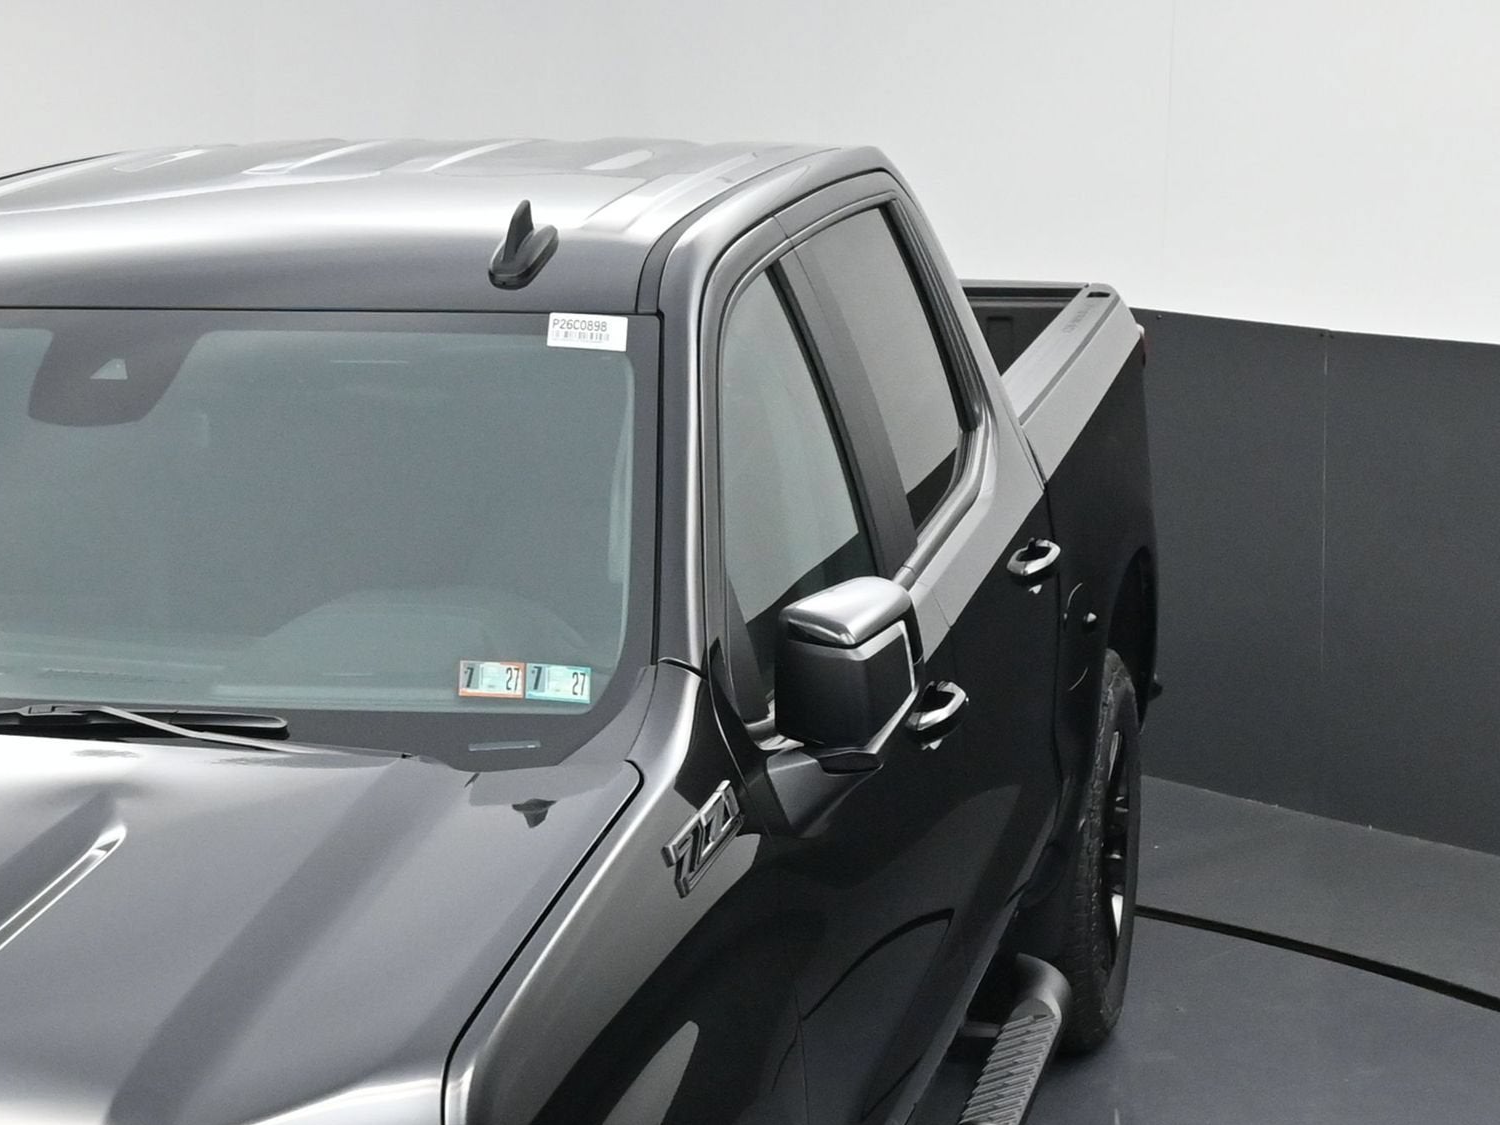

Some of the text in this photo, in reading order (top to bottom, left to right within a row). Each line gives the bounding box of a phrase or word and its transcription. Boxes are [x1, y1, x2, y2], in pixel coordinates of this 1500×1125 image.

[552, 318, 608, 332] P26C0898
[464, 666, 520, 692] 7 27
[531, 665, 587, 696] 7 27
[660, 778, 743, 898] Z71
